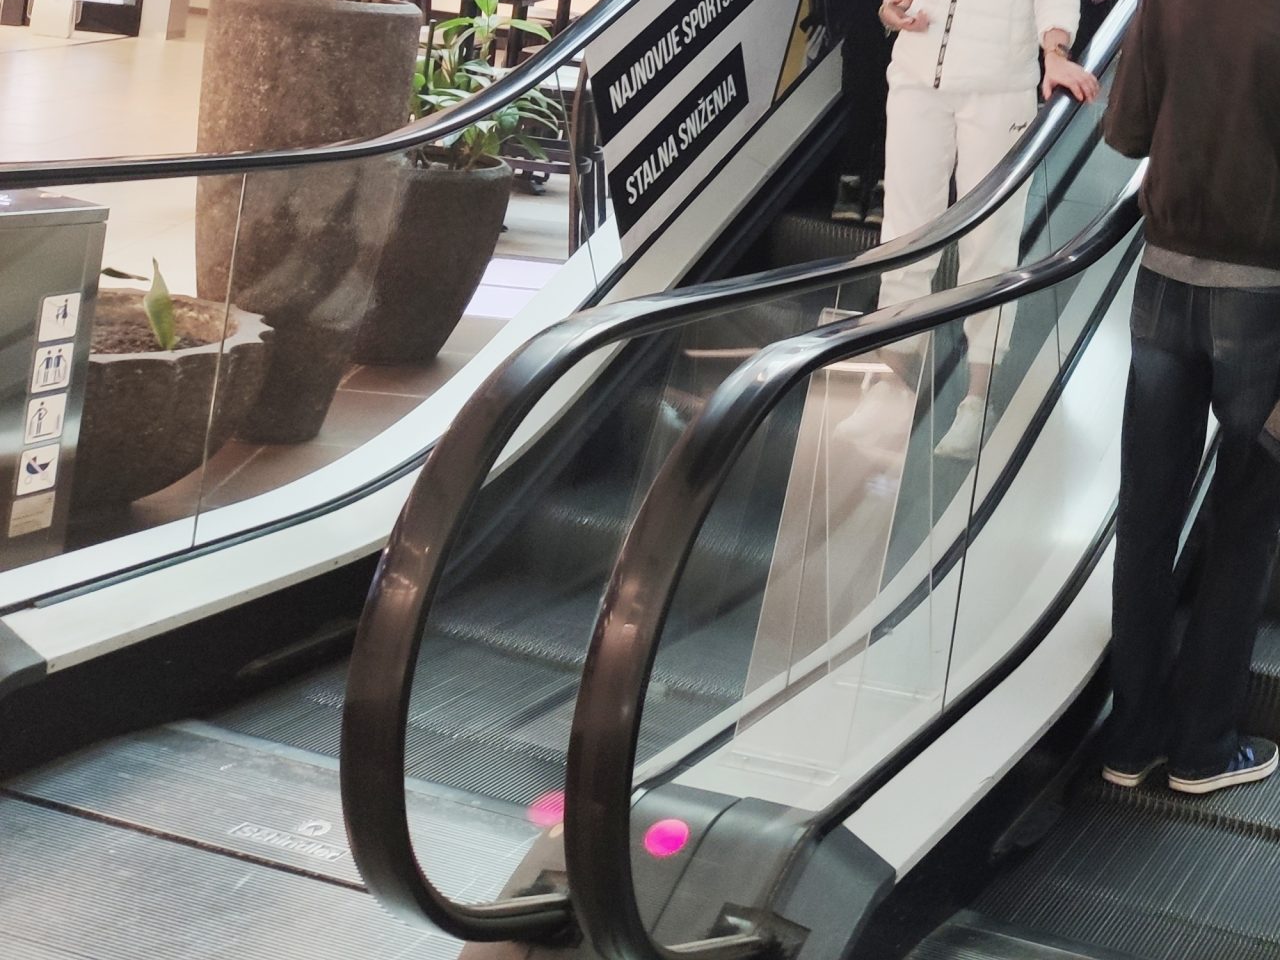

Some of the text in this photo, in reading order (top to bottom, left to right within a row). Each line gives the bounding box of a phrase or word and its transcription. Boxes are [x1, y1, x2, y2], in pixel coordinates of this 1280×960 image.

[609, 25, 682, 114] NAJNOVIJE
[625, 74, 737, 205] STALNA SNIŽENJA
